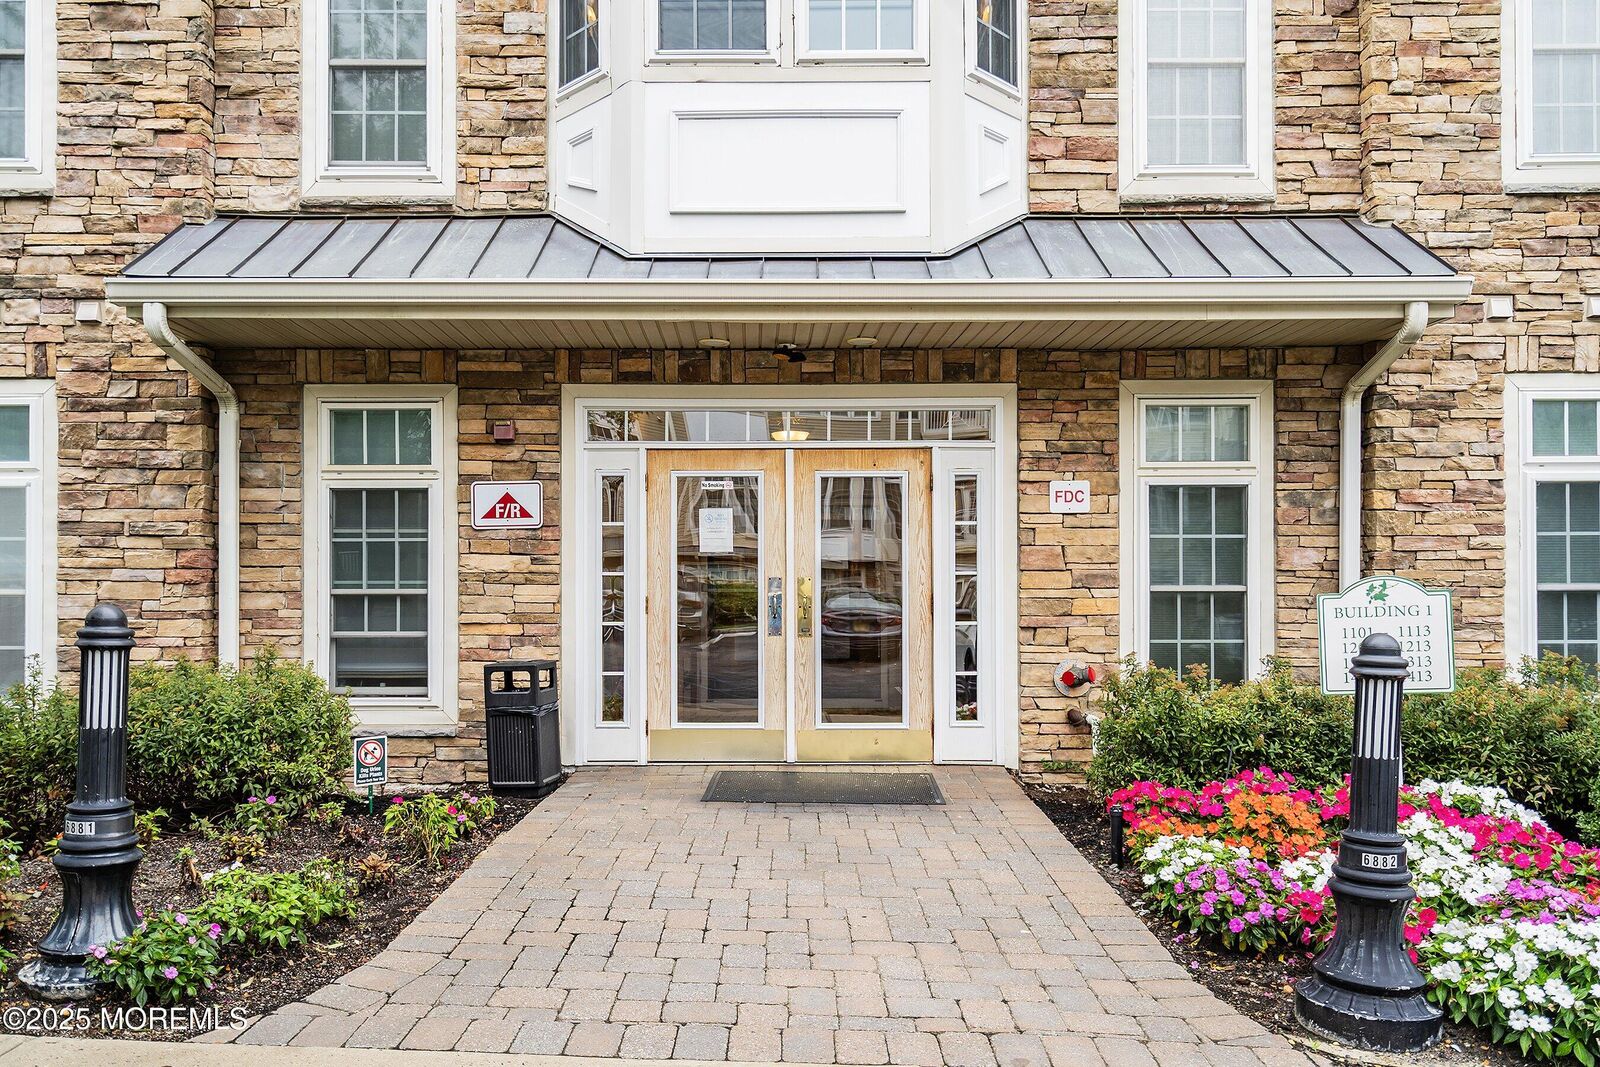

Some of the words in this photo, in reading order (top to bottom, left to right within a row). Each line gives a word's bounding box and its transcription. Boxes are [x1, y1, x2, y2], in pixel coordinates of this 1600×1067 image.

[1055, 490, 1085, 503] FDC
[495, 503, 521, 518] F/R
[1334, 605, 1420, 619] BUILDING
[1427, 605, 1432, 616] 1
[1343, 627, 1373, 638] 1101
[1399, 625, 1431, 637] 1113
[1343, 642, 1358, 654] 12
[1407, 656, 1432, 667] 313
[1408, 671, 1433, 682] 413
[1363, 854, 1396, 868] 6882
